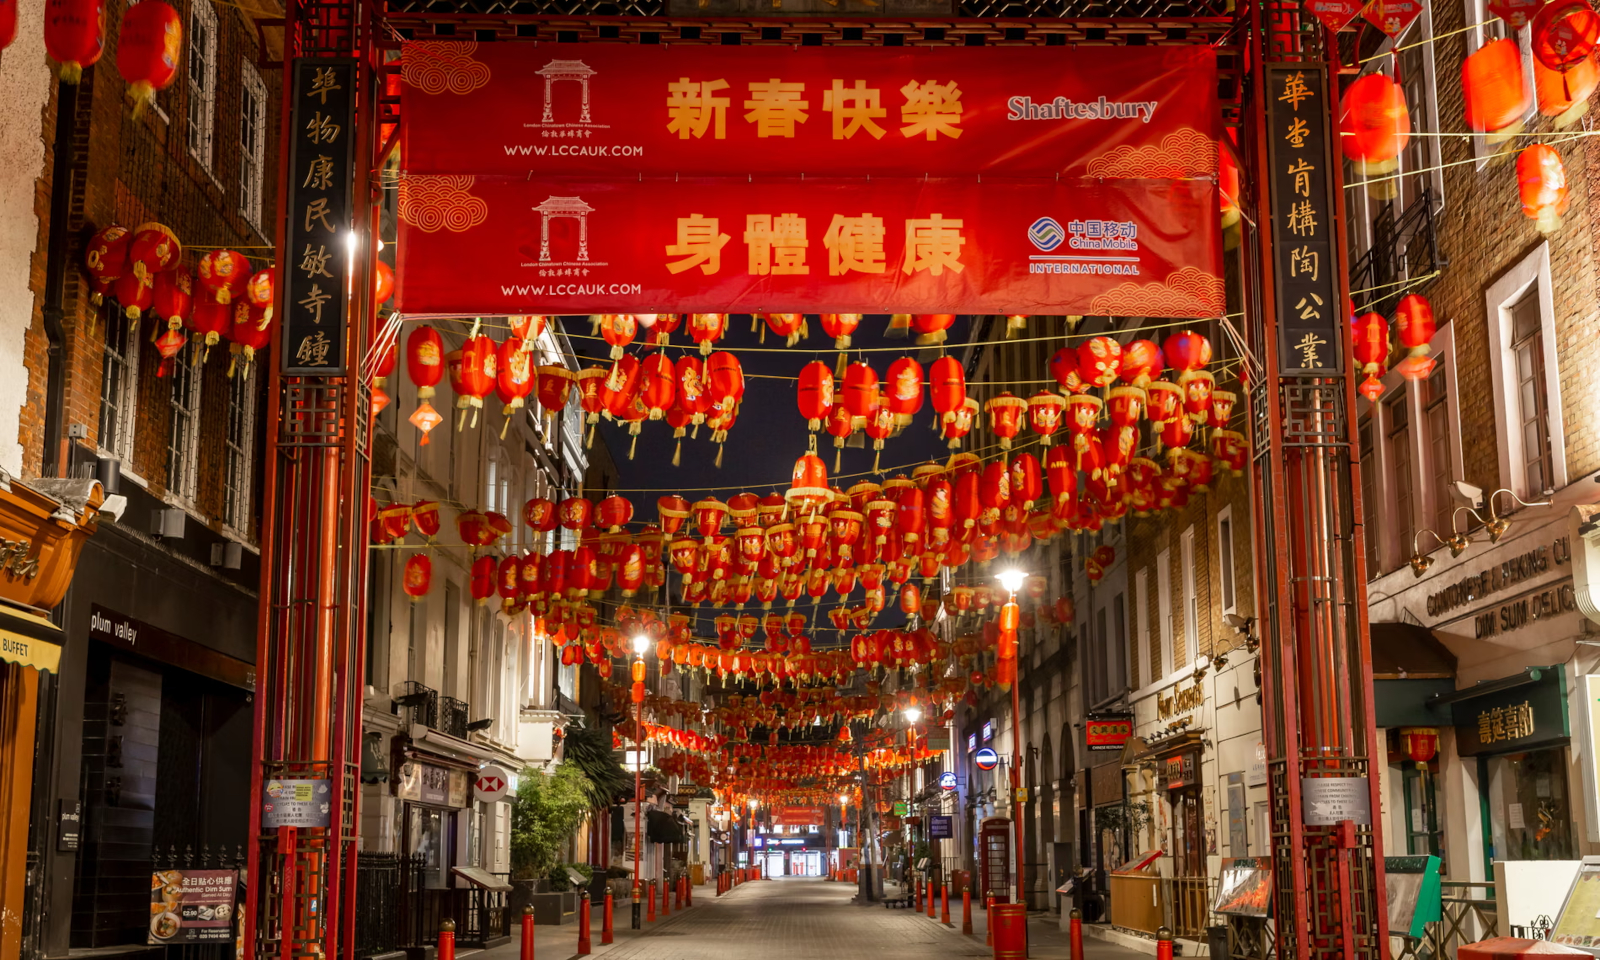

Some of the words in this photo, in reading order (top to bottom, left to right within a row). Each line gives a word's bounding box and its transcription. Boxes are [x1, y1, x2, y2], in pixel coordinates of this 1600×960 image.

[666, 77, 963, 141] 新春快樂
[1007, 95, 1158, 123] Shaftesbury
[504, 145, 643, 156] WWW.LCCAUK.COM
[1068, 219, 1137, 239] 中国移动
[665, 213, 965, 276] 身體健康
[1069, 238, 1100, 249] China
[1102, 239, 1138, 250] Mobile
[1029, 263, 1140, 275] INTERNATIONAL
[501, 284, 641, 296] WWW.LCCAUK.COM
[1475, 611, 1495, 639] DIM
[1501, 600, 1527, 631] SUM
[1533, 584, 1574, 620] DELIC
[91, 611, 111, 634] plum
[114, 621, 137, 645] valley
[3, 638, 28, 657] BUFFET
